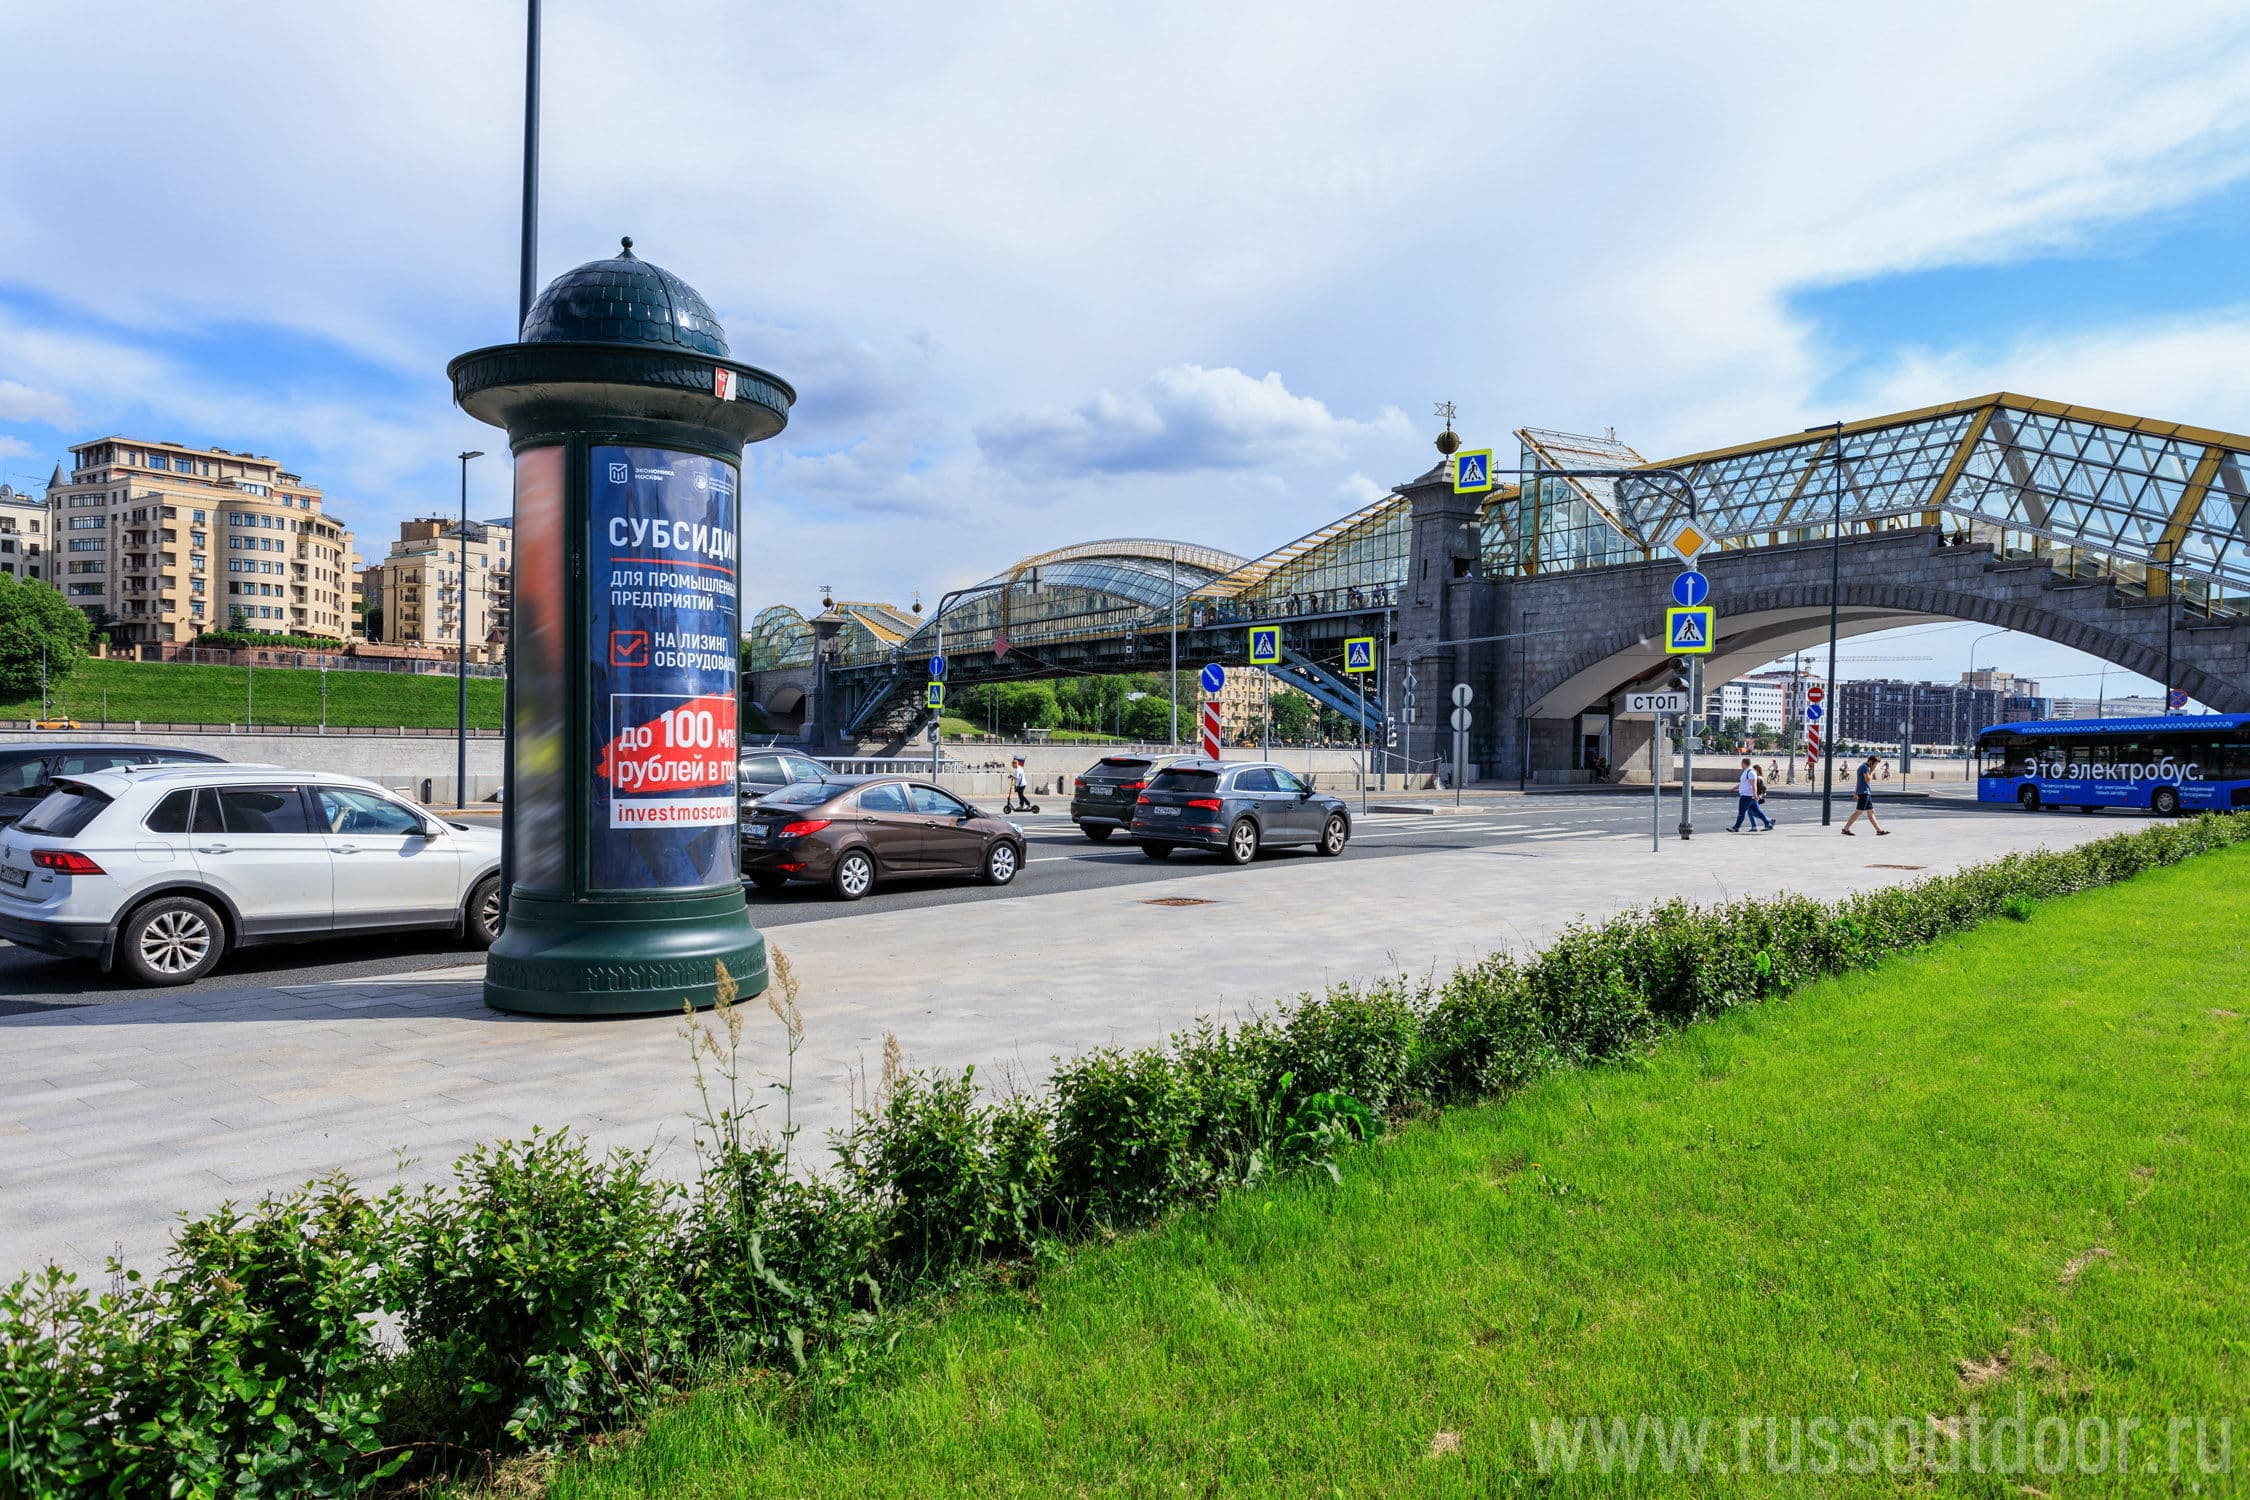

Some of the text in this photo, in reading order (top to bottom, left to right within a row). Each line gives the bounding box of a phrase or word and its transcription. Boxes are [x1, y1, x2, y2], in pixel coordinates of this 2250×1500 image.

[634, 467, 675, 477] ЭКОНОМИКА
[610, 570, 643, 588] ДЛЯ
[611, 590, 714, 612] ПРЕДПРИЯТИЙ
[655, 632, 727, 652] НА ЛИЗИНГ
[1633, 695, 1678, 710] СТОП
[618, 727, 653, 752] до
[660, 710, 713, 749] 100
[617, 754, 705, 789] рублей
[708, 760, 719, 781] в
[2023, 756, 2204, 787] Это электробус.
